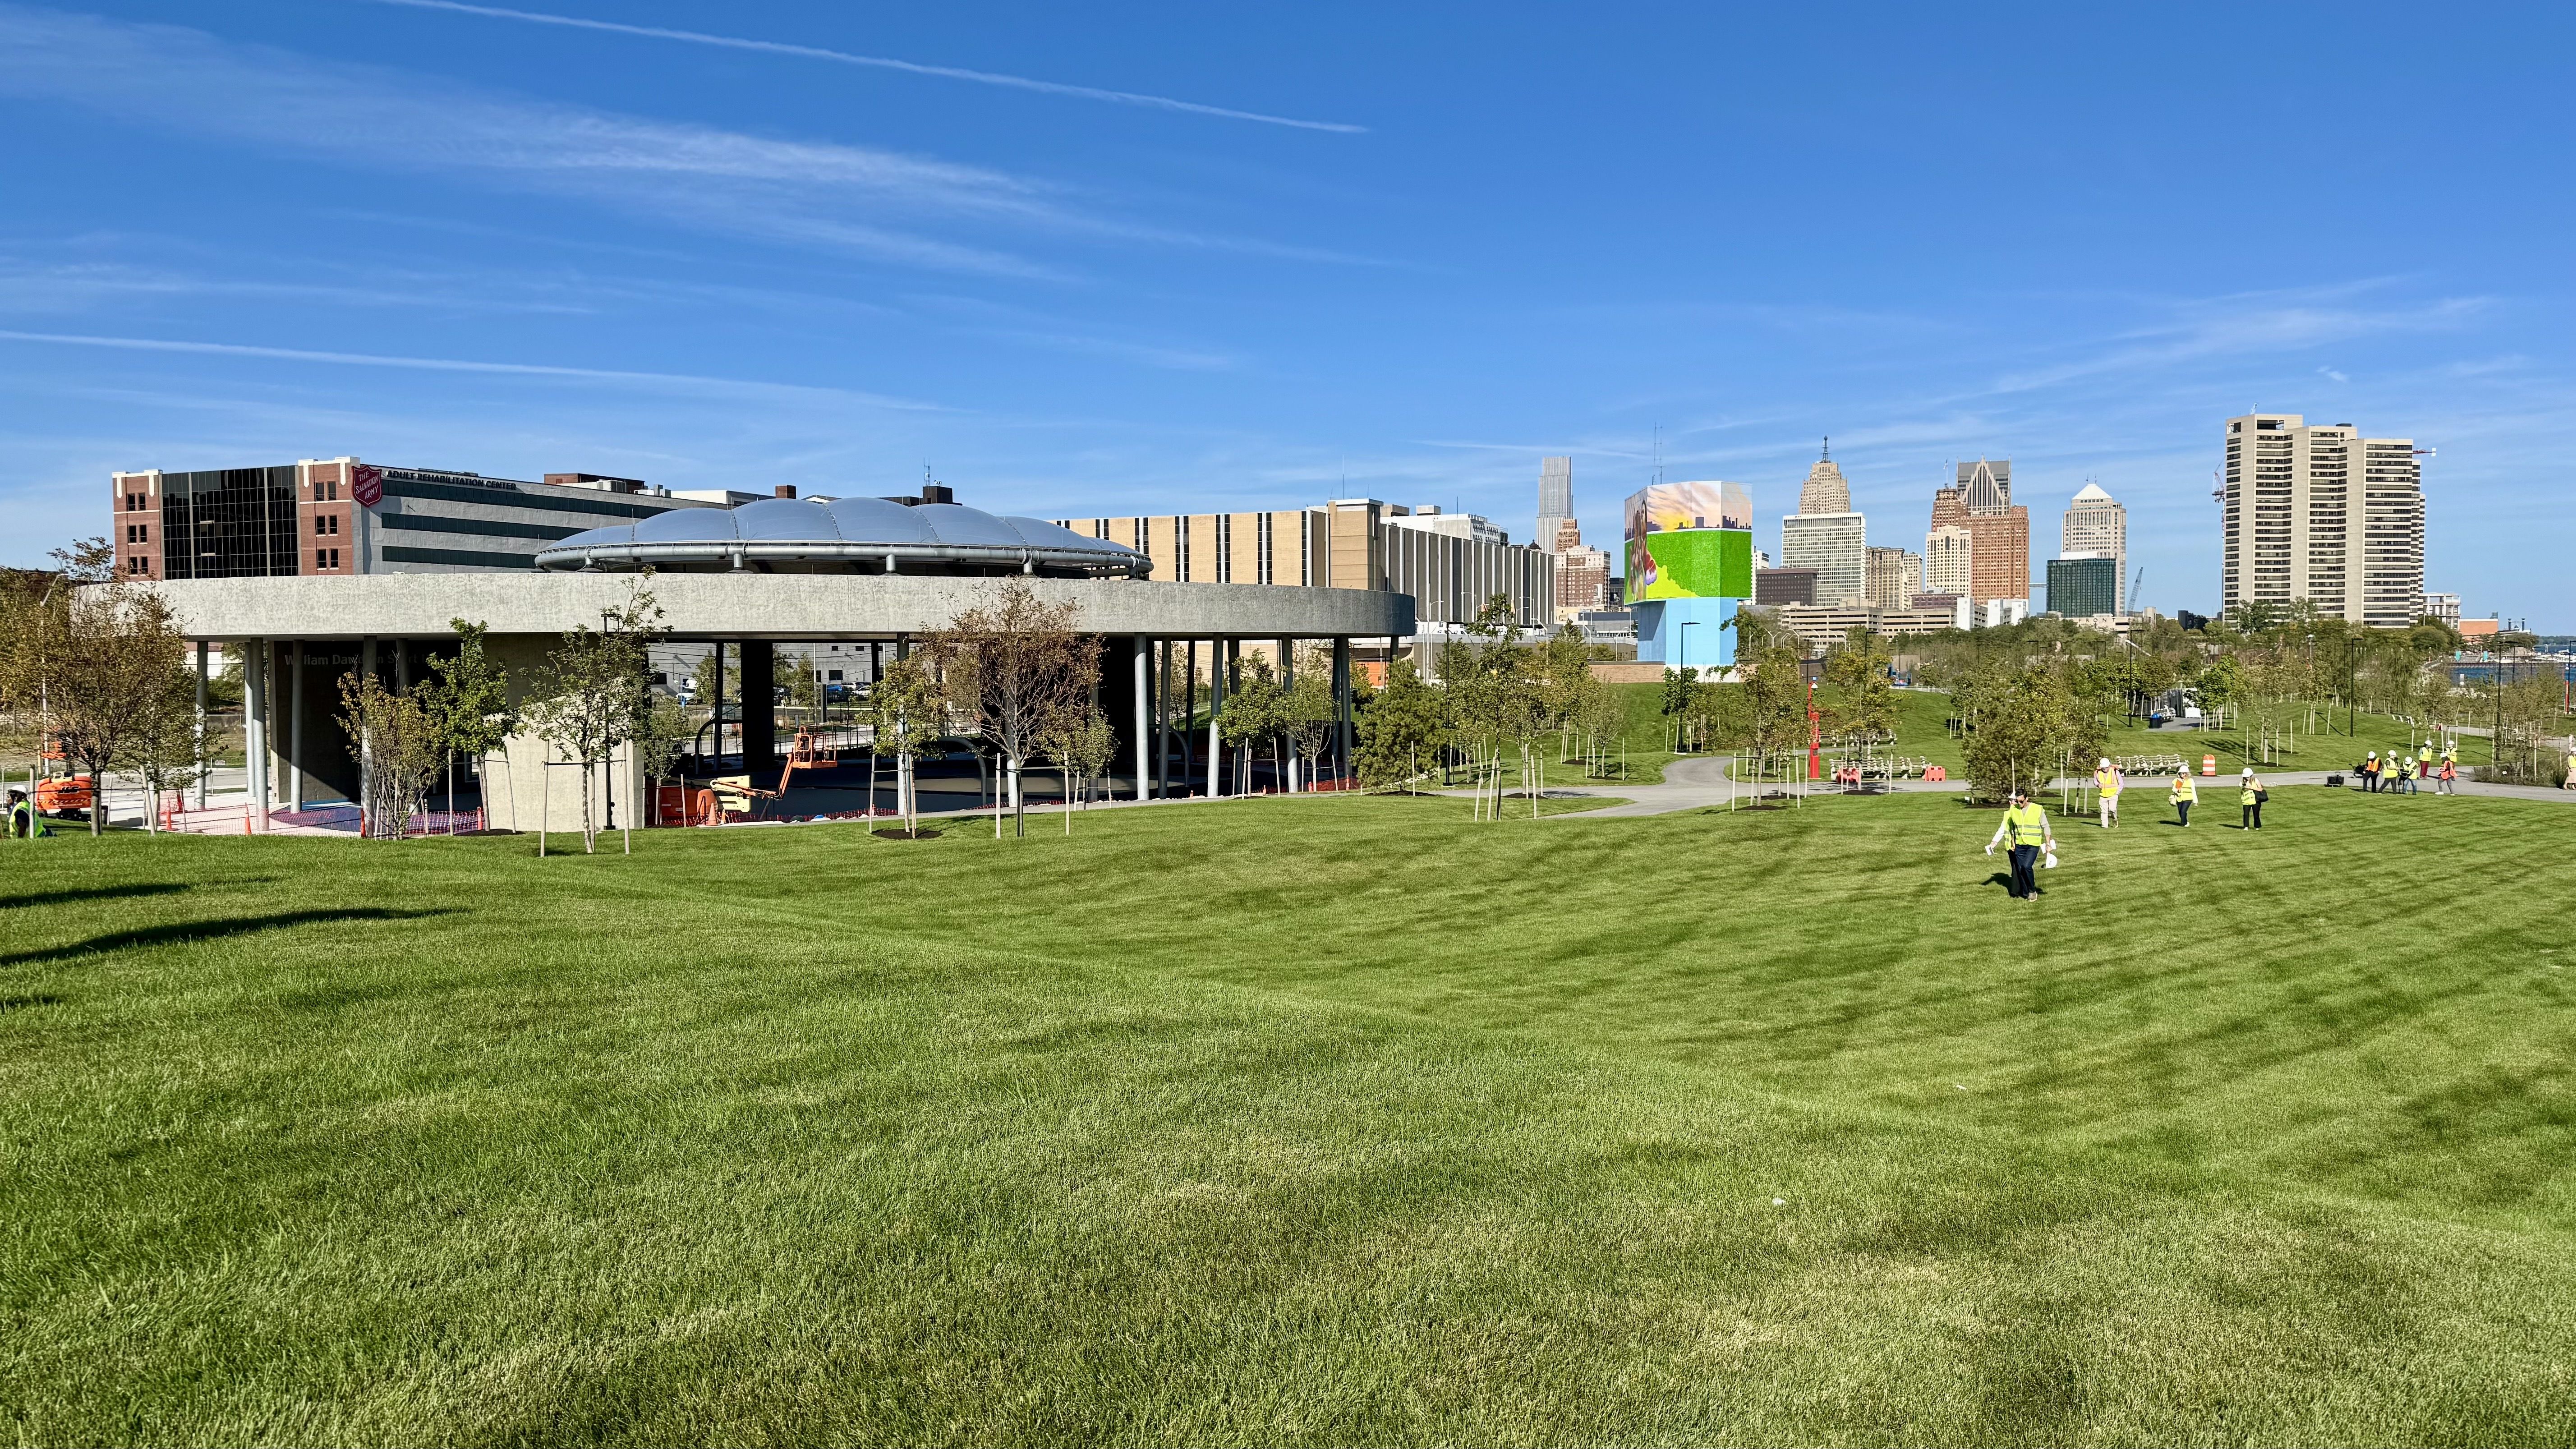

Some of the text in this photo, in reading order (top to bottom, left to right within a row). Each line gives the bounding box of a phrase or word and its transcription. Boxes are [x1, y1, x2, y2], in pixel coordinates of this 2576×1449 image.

[355, 474, 378, 494] SALVATION
[359, 471, 369, 482] THE
[387, 470, 516, 490] ADULT REHABILITATION CENTER
[364, 484, 378, 499] ARMY
[285, 654, 329, 665] Wliam
